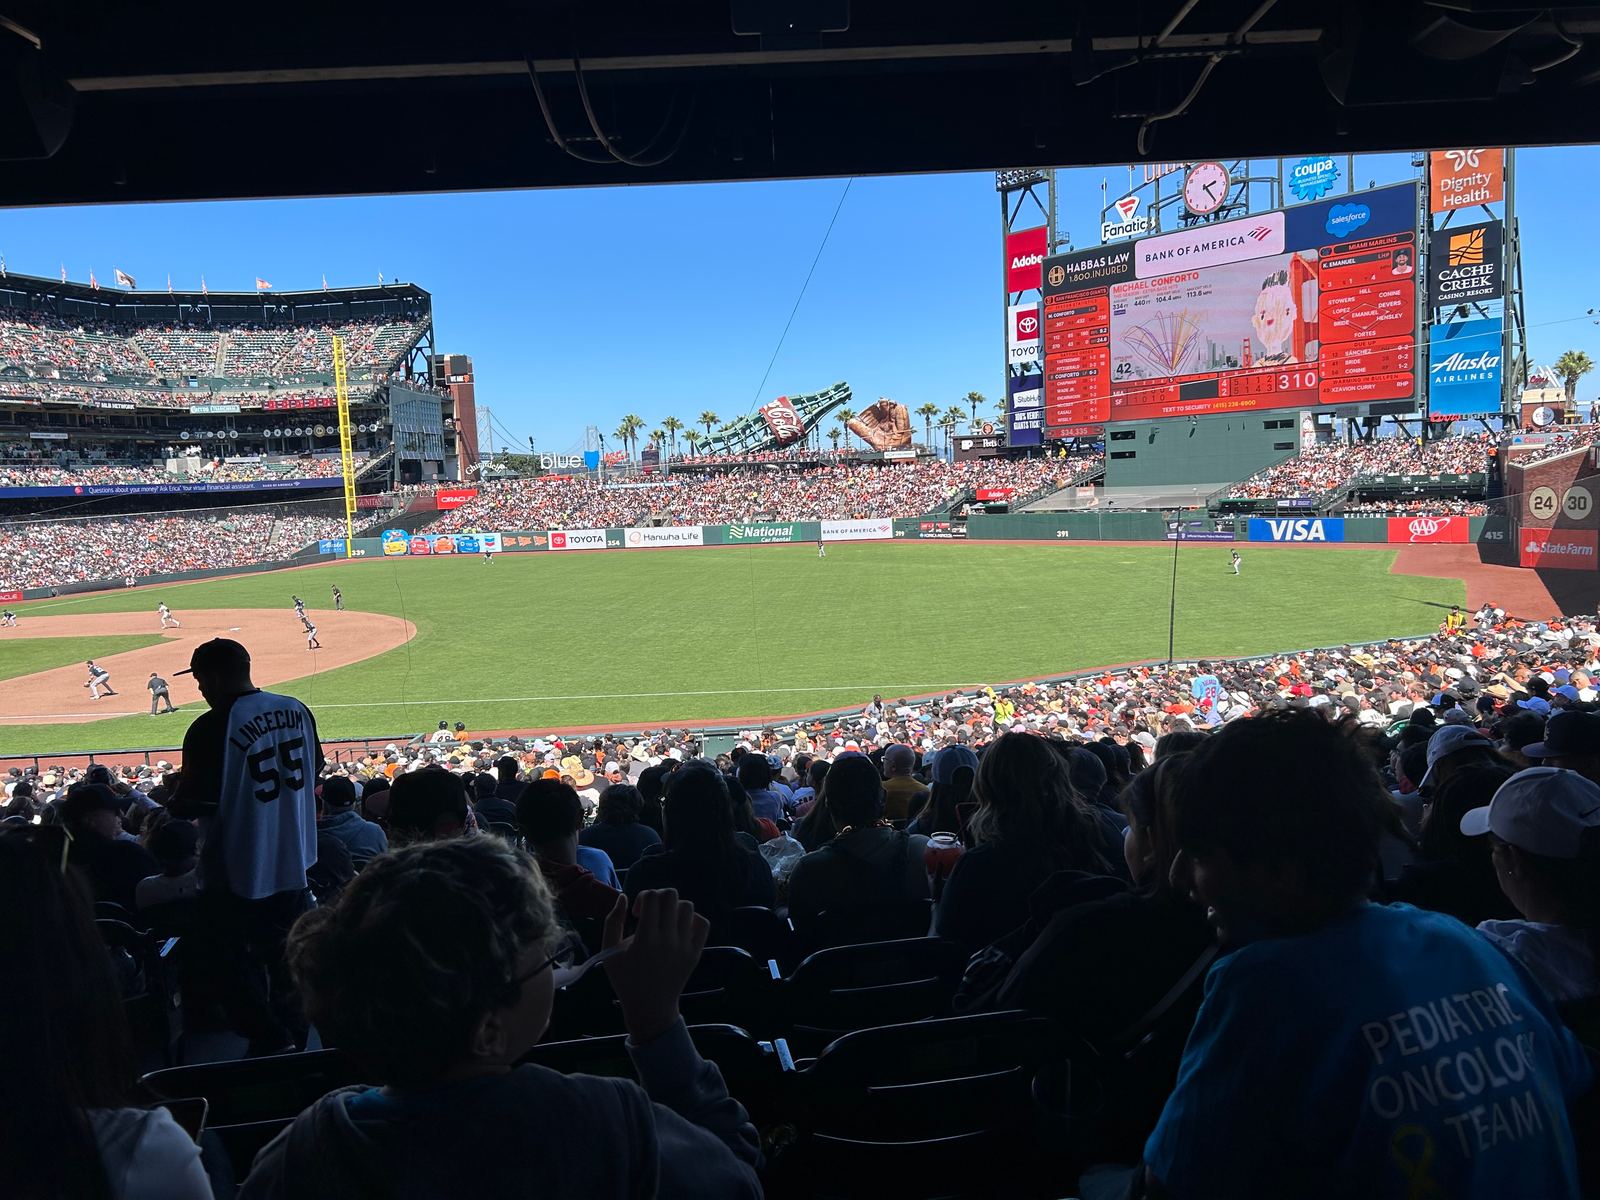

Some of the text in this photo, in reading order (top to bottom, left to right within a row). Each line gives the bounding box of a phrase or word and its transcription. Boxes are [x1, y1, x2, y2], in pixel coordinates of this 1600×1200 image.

[1295, 160, 1332, 177] coupa
[1440, 172, 1492, 192] Dignity
[1443, 189, 1490, 207] Health
[1332, 212, 1366, 224] salesforce
[1104, 218, 1152, 238] Fanatics
[1145, 236, 1245, 262] BANK OF AMERICA
[1368, 237, 1397, 246] MARLINS
[1012, 254, 1043, 268] Adobe
[1066, 252, 1130, 274] HABBAS LAW
[1329, 259, 1356, 267] EMANUEL
[1438, 264, 1494, 280] CACHE
[1113, 281, 1148, 293] MICHAEL
[1151, 272, 1199, 287] CONFORTO
[1440, 276, 1492, 292] CREEK
[1328, 297, 1355, 305] STOWERS
[1438, 288, 1493, 300] CASINO RESORT
[1117, 363, 1131, 374] 42
[1432, 351, 1500, 373] Alaska
[1436, 372, 1493, 383] AIRLINES
[768, 408, 800, 438] Cola
[1014, 421, 1029, 430] GIANTS
[540, 452, 581, 470] blue
[360, 498, 381, 506] GUNITAS
[1534, 496, 1553, 509] 24
[1568, 496, 1586, 510] 30
[744, 525, 792, 537] National
[1265, 520, 1325, 540] VISA
[1412, 522, 1434, 533] AAA
[1485, 532, 1503, 540] 415
[1206, 686, 1216, 698] 28
[229, 710, 304, 752] LINCECUM
[247, 737, 304, 803] 55
[1361, 982, 1524, 1065] PEDIATRIC
[1444, 1090, 1544, 1160] TEAM
